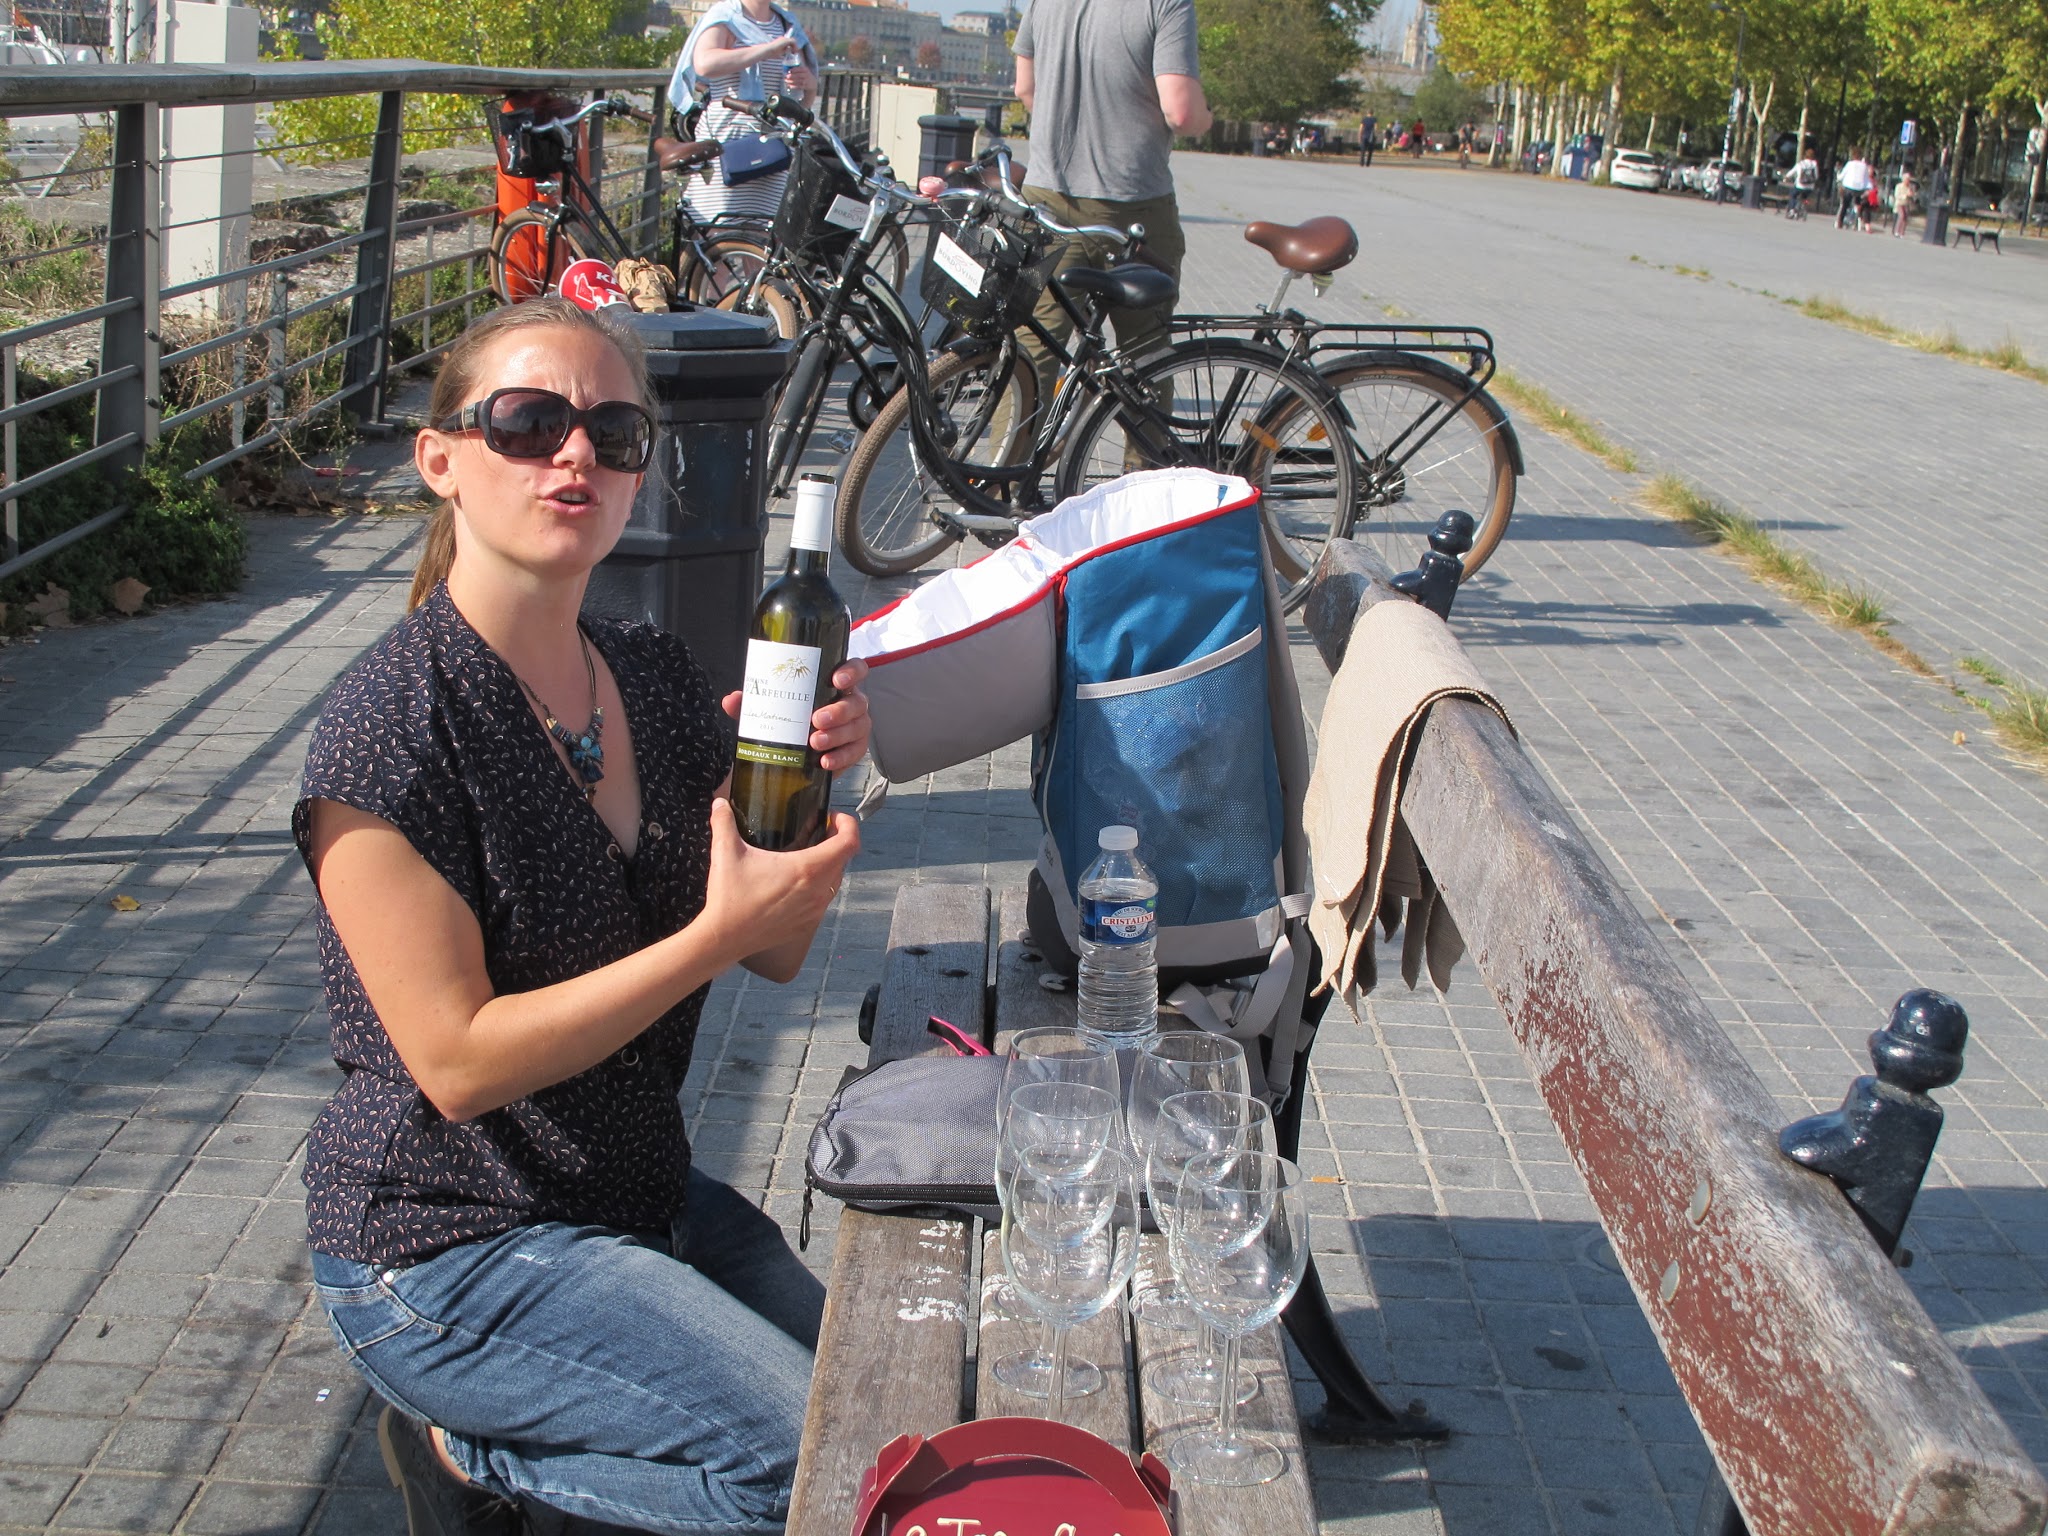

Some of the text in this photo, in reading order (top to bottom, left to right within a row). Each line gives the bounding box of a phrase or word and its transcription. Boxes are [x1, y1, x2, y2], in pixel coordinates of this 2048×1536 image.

[938, 247, 978, 286] BORDOVINO
[738, 747, 800, 763] BORDEAUX BLANC
